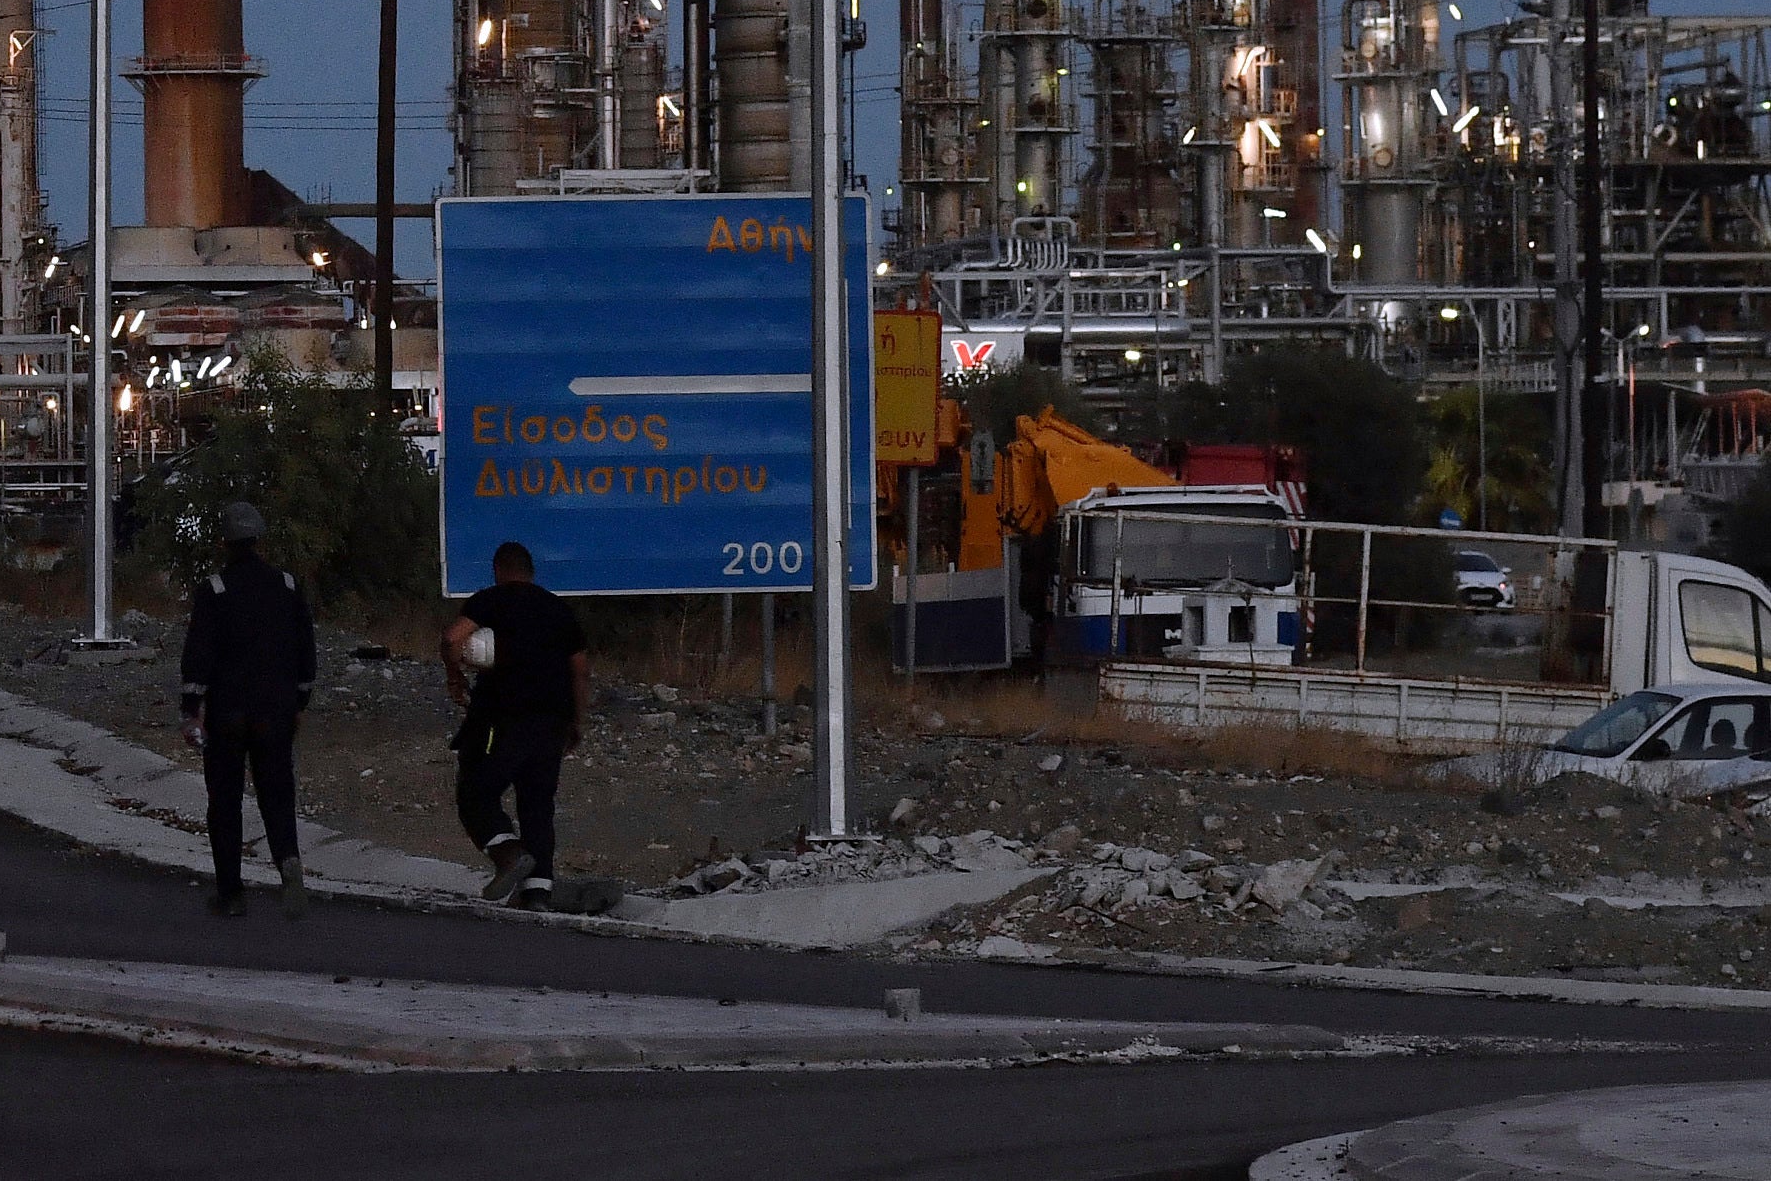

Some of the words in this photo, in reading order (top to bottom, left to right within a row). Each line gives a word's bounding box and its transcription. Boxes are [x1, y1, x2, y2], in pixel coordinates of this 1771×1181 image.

[706, 215, 813, 263] Αθήν
[472, 404, 668, 451] Είσοδος
[722, 540, 803, 576] 200
